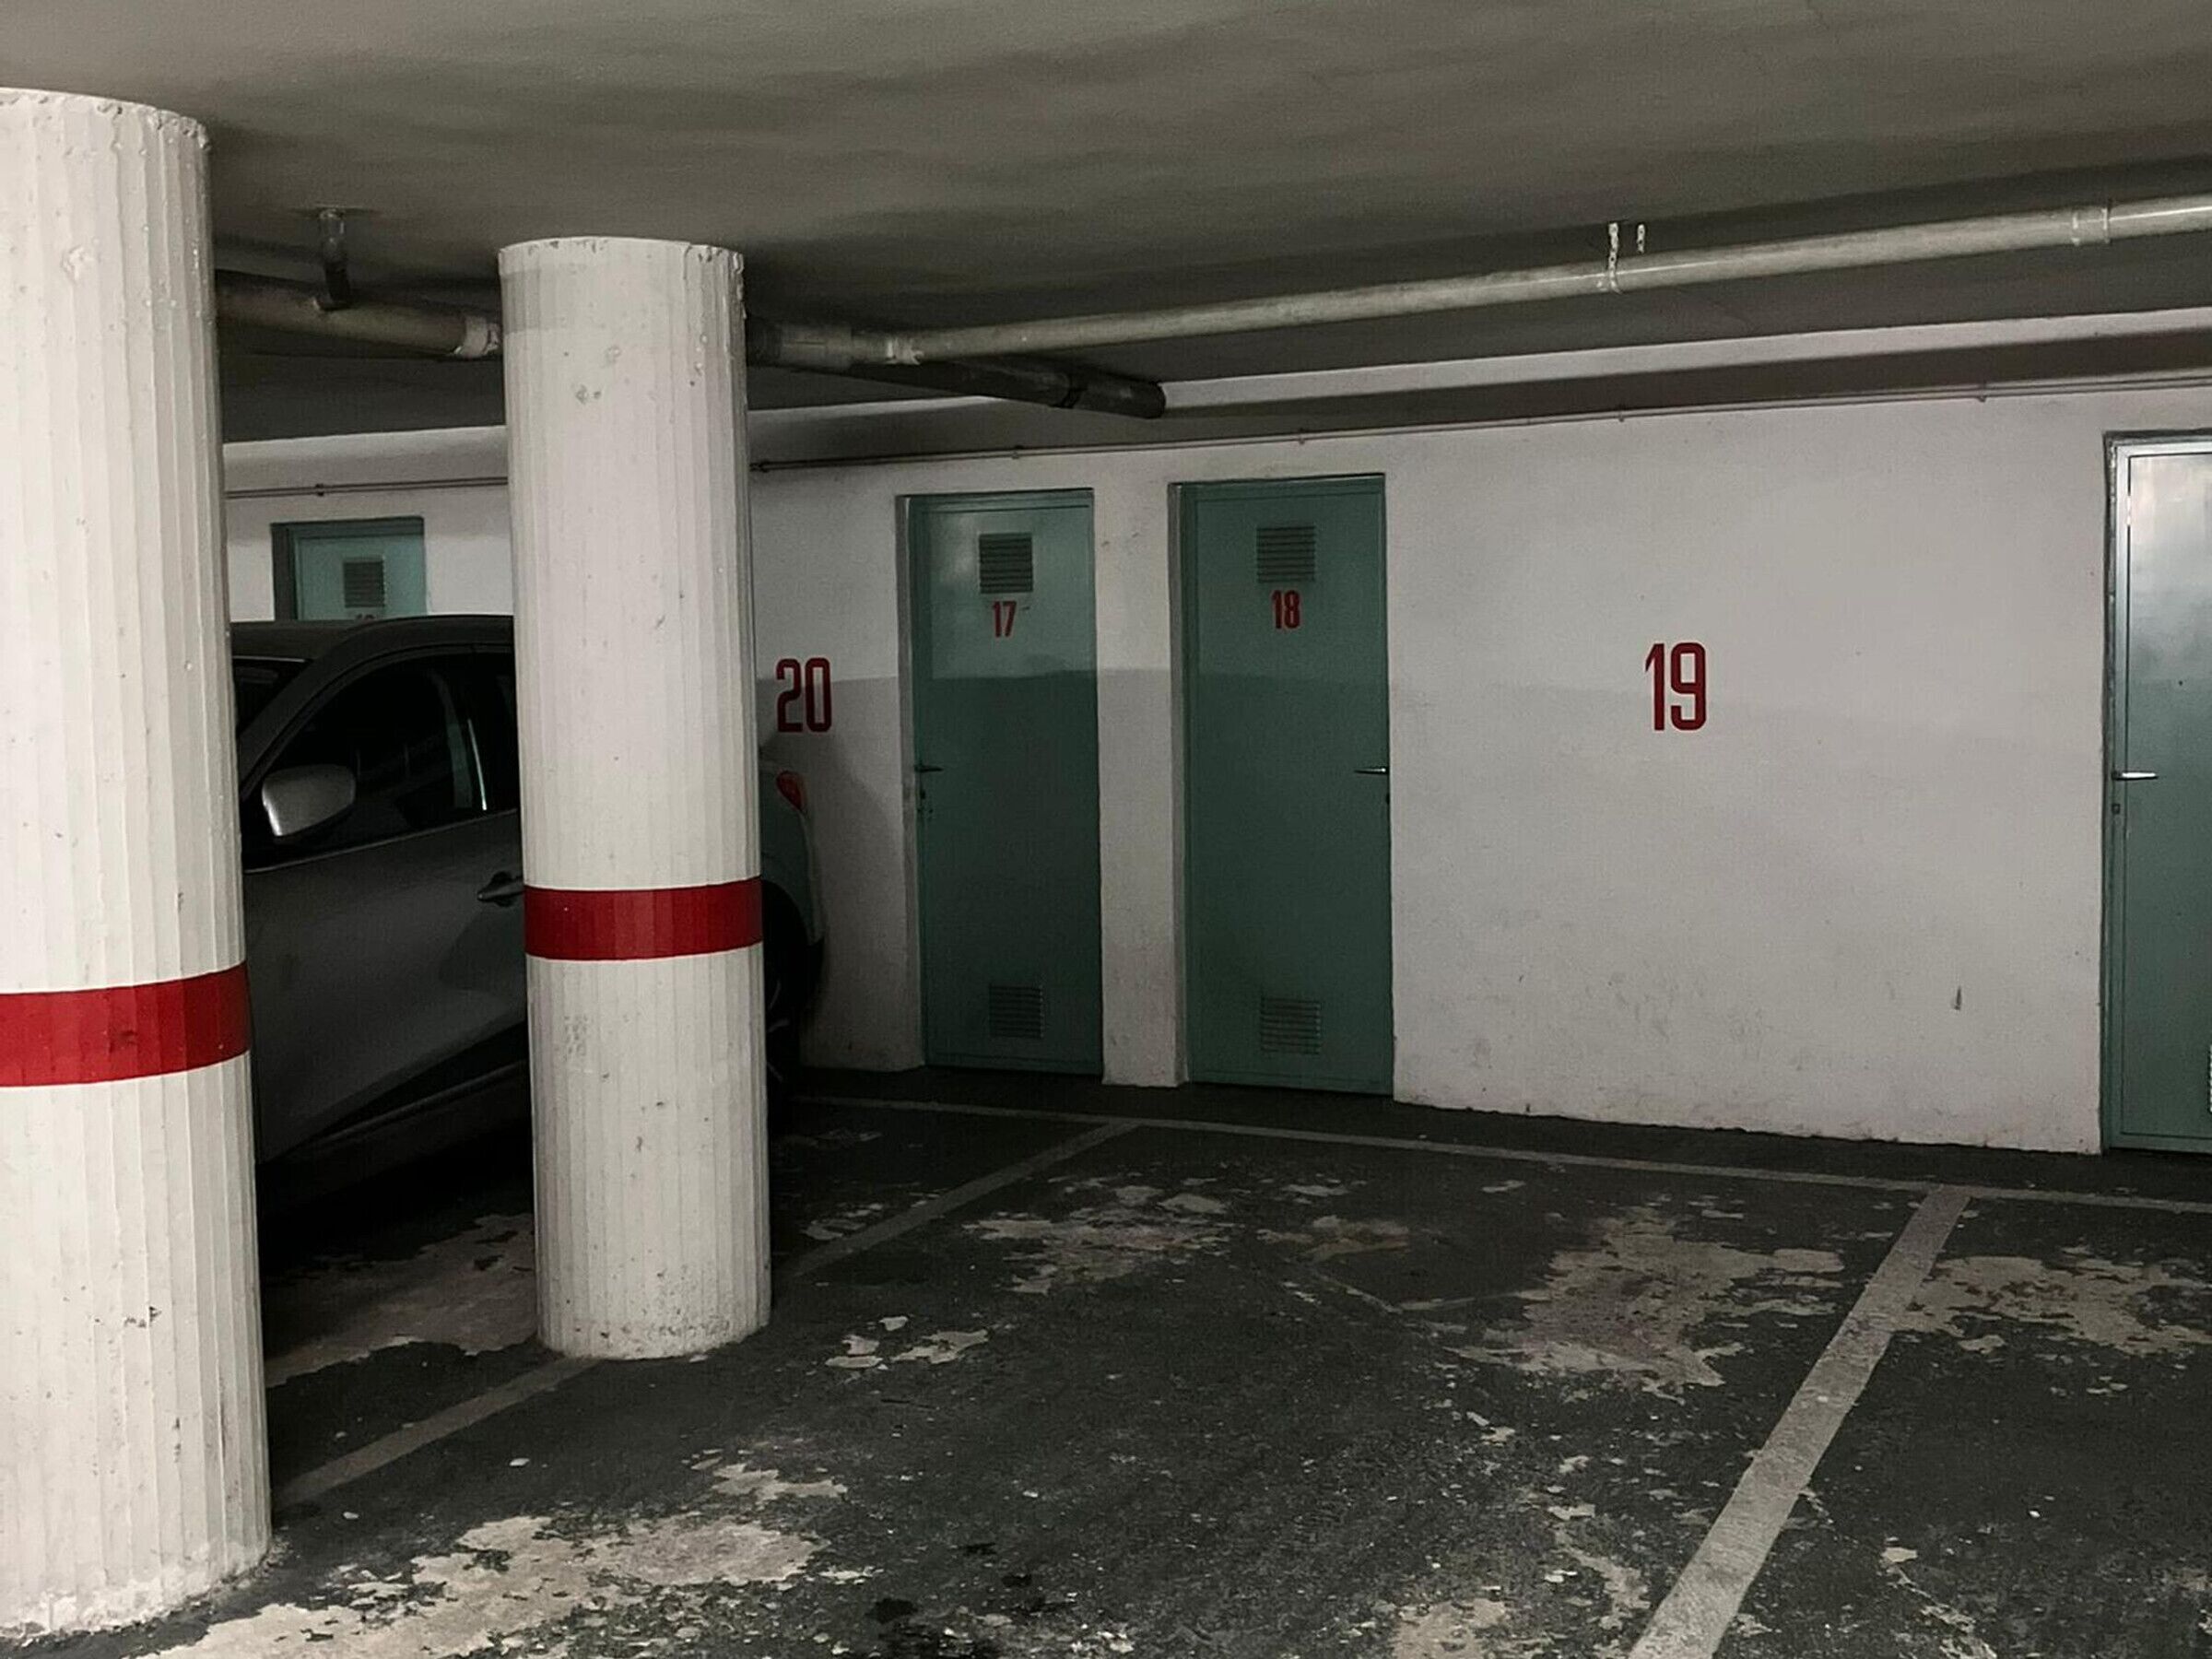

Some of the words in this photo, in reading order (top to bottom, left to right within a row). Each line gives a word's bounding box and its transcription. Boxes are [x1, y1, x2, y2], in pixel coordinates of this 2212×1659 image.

[993, 601, 1017, 637] 17
[1272, 591, 1300, 629] 18
[777, 658, 831, 732] 20
[1645, 642, 1707, 732] 19
